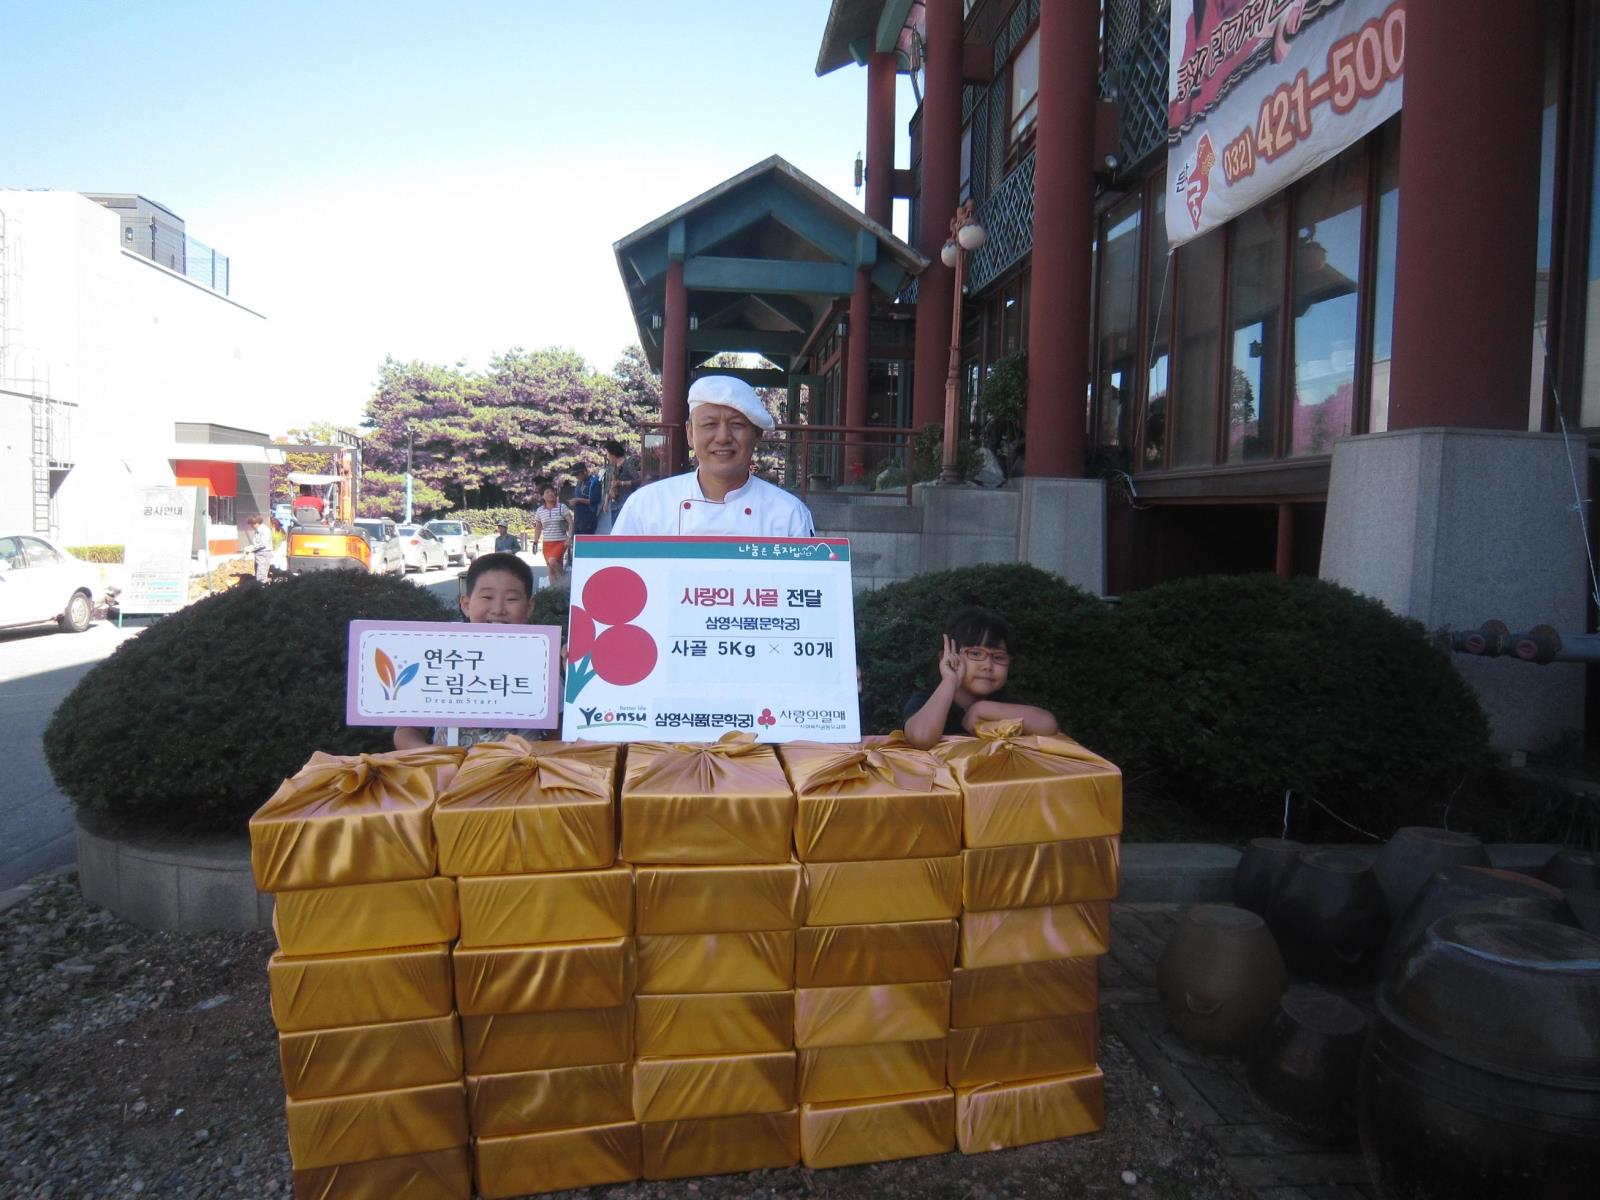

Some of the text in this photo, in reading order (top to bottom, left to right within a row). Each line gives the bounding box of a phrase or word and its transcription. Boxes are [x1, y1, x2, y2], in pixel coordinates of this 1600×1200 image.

[738, 543, 767, 557] 나눔은
[680, 587, 823, 608] 사랑의 사골 전달
[705, 616, 801, 631] 삼영식품(문학궁)
[671, 640, 708, 657] 사골
[717, 640, 756, 658] 5Kg
[793, 641, 834, 658] 30개
[424, 649, 485, 671] 연수구
[421, 673, 533, 697] 드림스타트
[579, 706, 647, 727] Yeonsu
[655, 712, 754, 729] 삼영식품(문학궁)
[779, 709, 846, 724] 사랑의열매
